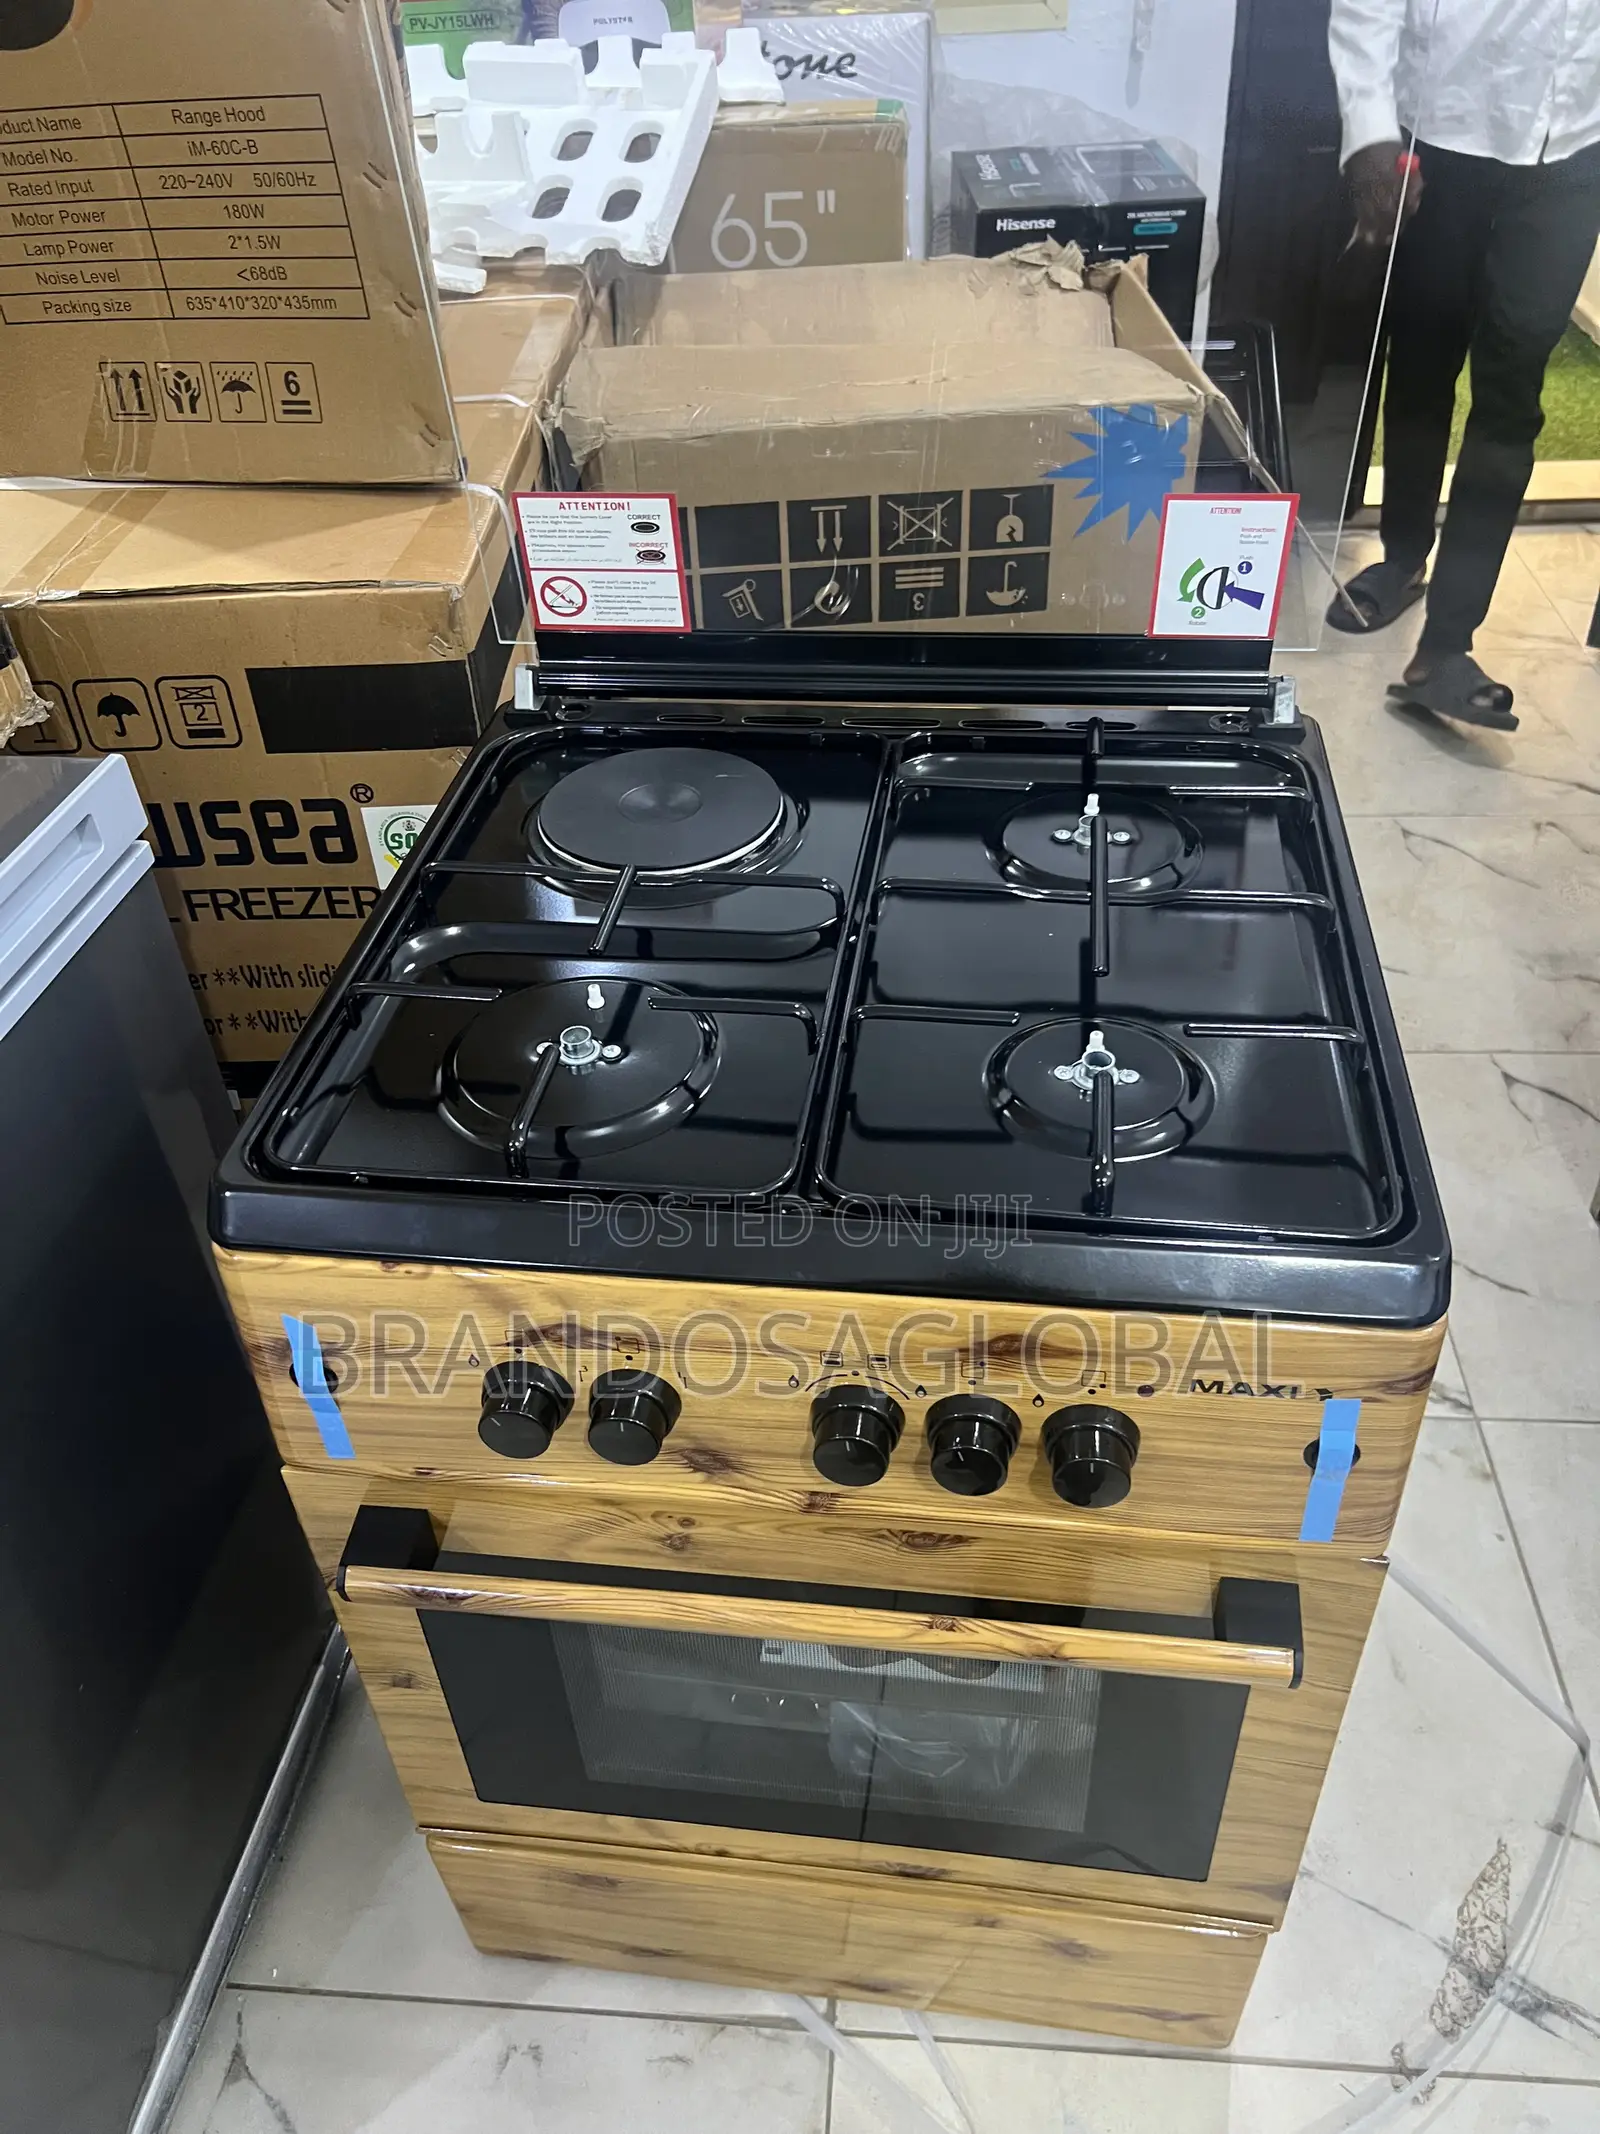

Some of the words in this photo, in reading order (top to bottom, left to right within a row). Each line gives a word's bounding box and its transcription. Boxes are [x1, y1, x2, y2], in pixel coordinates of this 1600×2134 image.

[409, 13, 494, 31] PV-JY15LWH
[171, 108, 222, 127] Range
[223, 106, 266, 123] Hood
[0, 118, 35, 135] duct
[36, 117, 82, 132] Name
[187, 139, 259, 157] iM-60C-B
[2, 149, 49, 167] Model
[50, 148, 78, 164] No.
[7, 181, 53, 197] Rated
[55, 178, 95, 197] Input
[159, 172, 233, 190] 220~240V
[252, 171, 317, 188] 50/60Hz
[11, 212, 54, 228] Motor
[59, 209, 106, 224] Power
[223, 203, 265, 219] 180W
[996, 218, 1056, 232] Hisense
[23, 242, 65, 259] Lamp
[67, 239, 114, 254] Power
[35, 271, 79, 286] Noise
[80, 268, 121, 284] Level
[236, 266, 288, 281] <68dB
[42, 299, 101, 316] Packing
[104, 298, 132, 313] size
[284, 370, 301, 397] 6
[558, 501, 631, 511] ATTENTION!
[181, 886, 384, 922] FREEZER
[1190, 1378, 1298, 1400] MAXI
